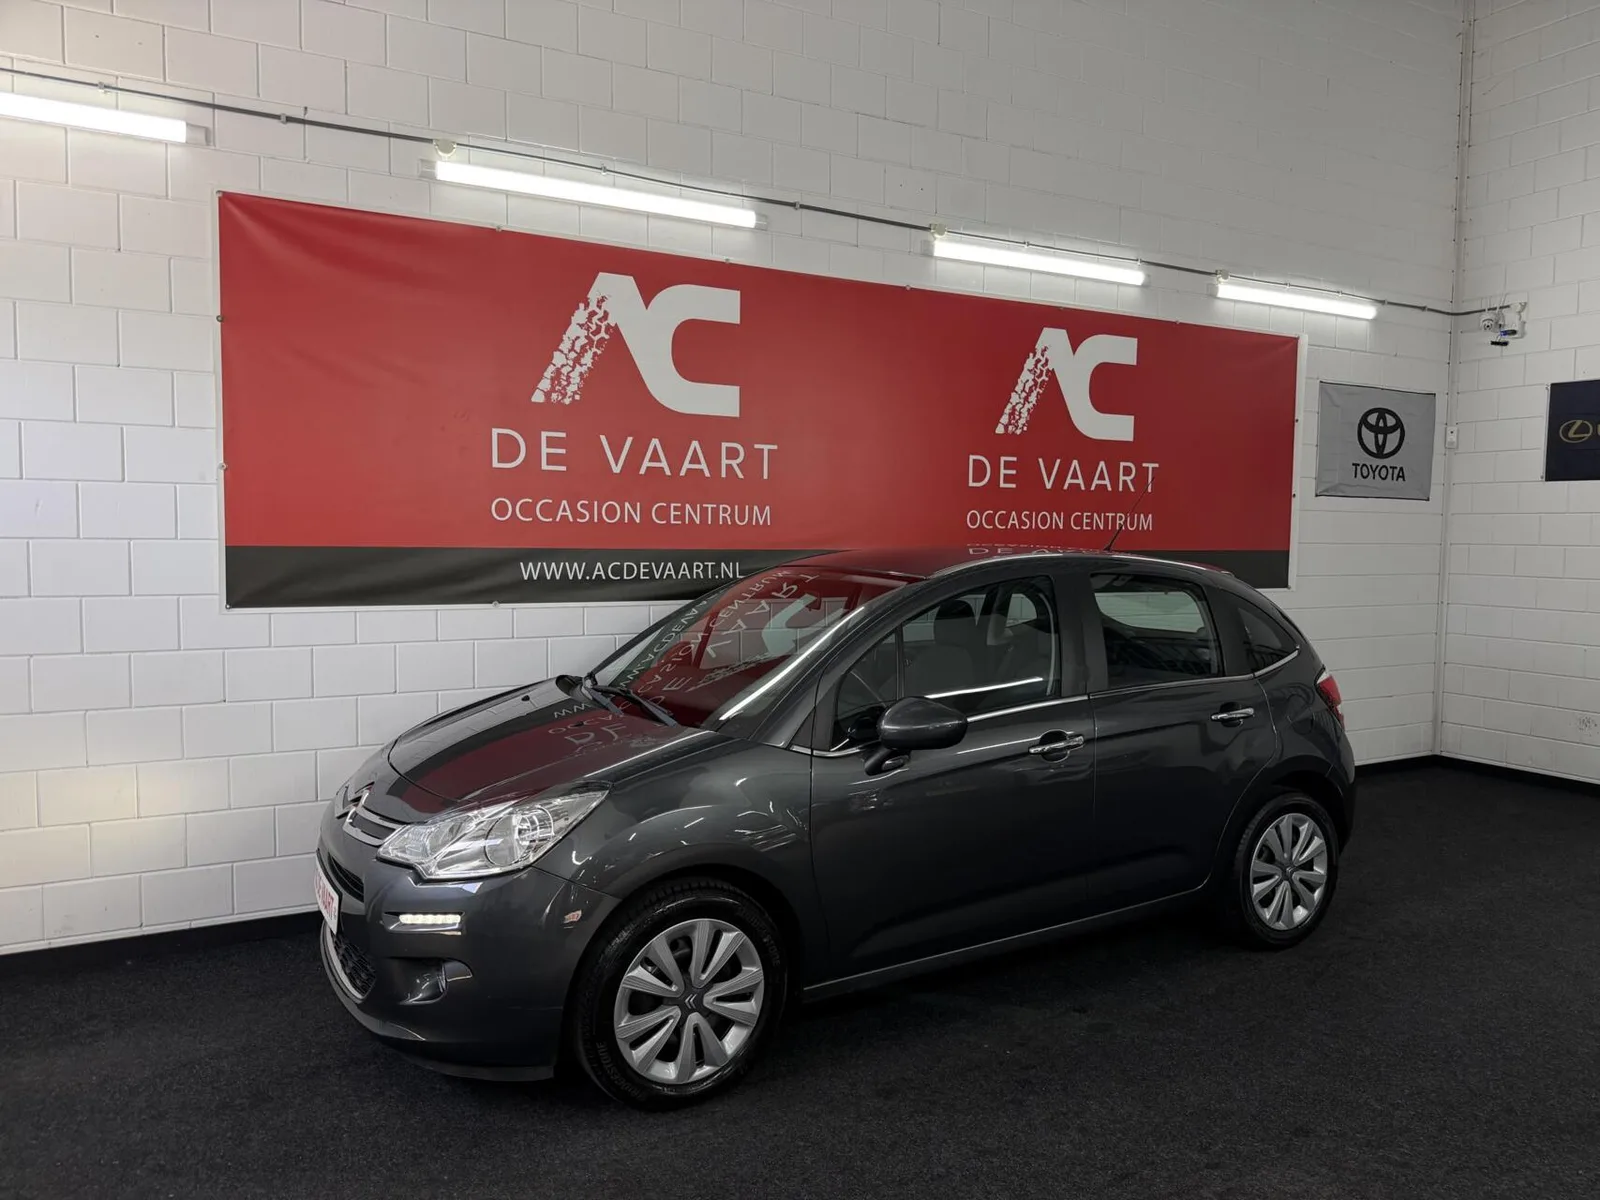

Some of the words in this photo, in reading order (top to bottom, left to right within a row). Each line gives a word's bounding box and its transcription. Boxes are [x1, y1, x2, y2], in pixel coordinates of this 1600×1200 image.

[531, 271, 741, 418] AC
[995, 327, 1138, 442] AC
[491, 427, 567, 472] DE
[599, 434, 778, 480] VAART
[968, 454, 1018, 489] DE
[1038, 457, 1160, 493] VAART
[1352, 462, 1406, 482] TOYOTA
[491, 497, 641, 523] OCCASION
[651, 502, 772, 526] CENTRUM
[966, 510, 1064, 530] OCCASION
[1070, 511, 1154, 531] CENTRUM
[519, 561, 745, 581] WWW.ACDEVAART.NL
